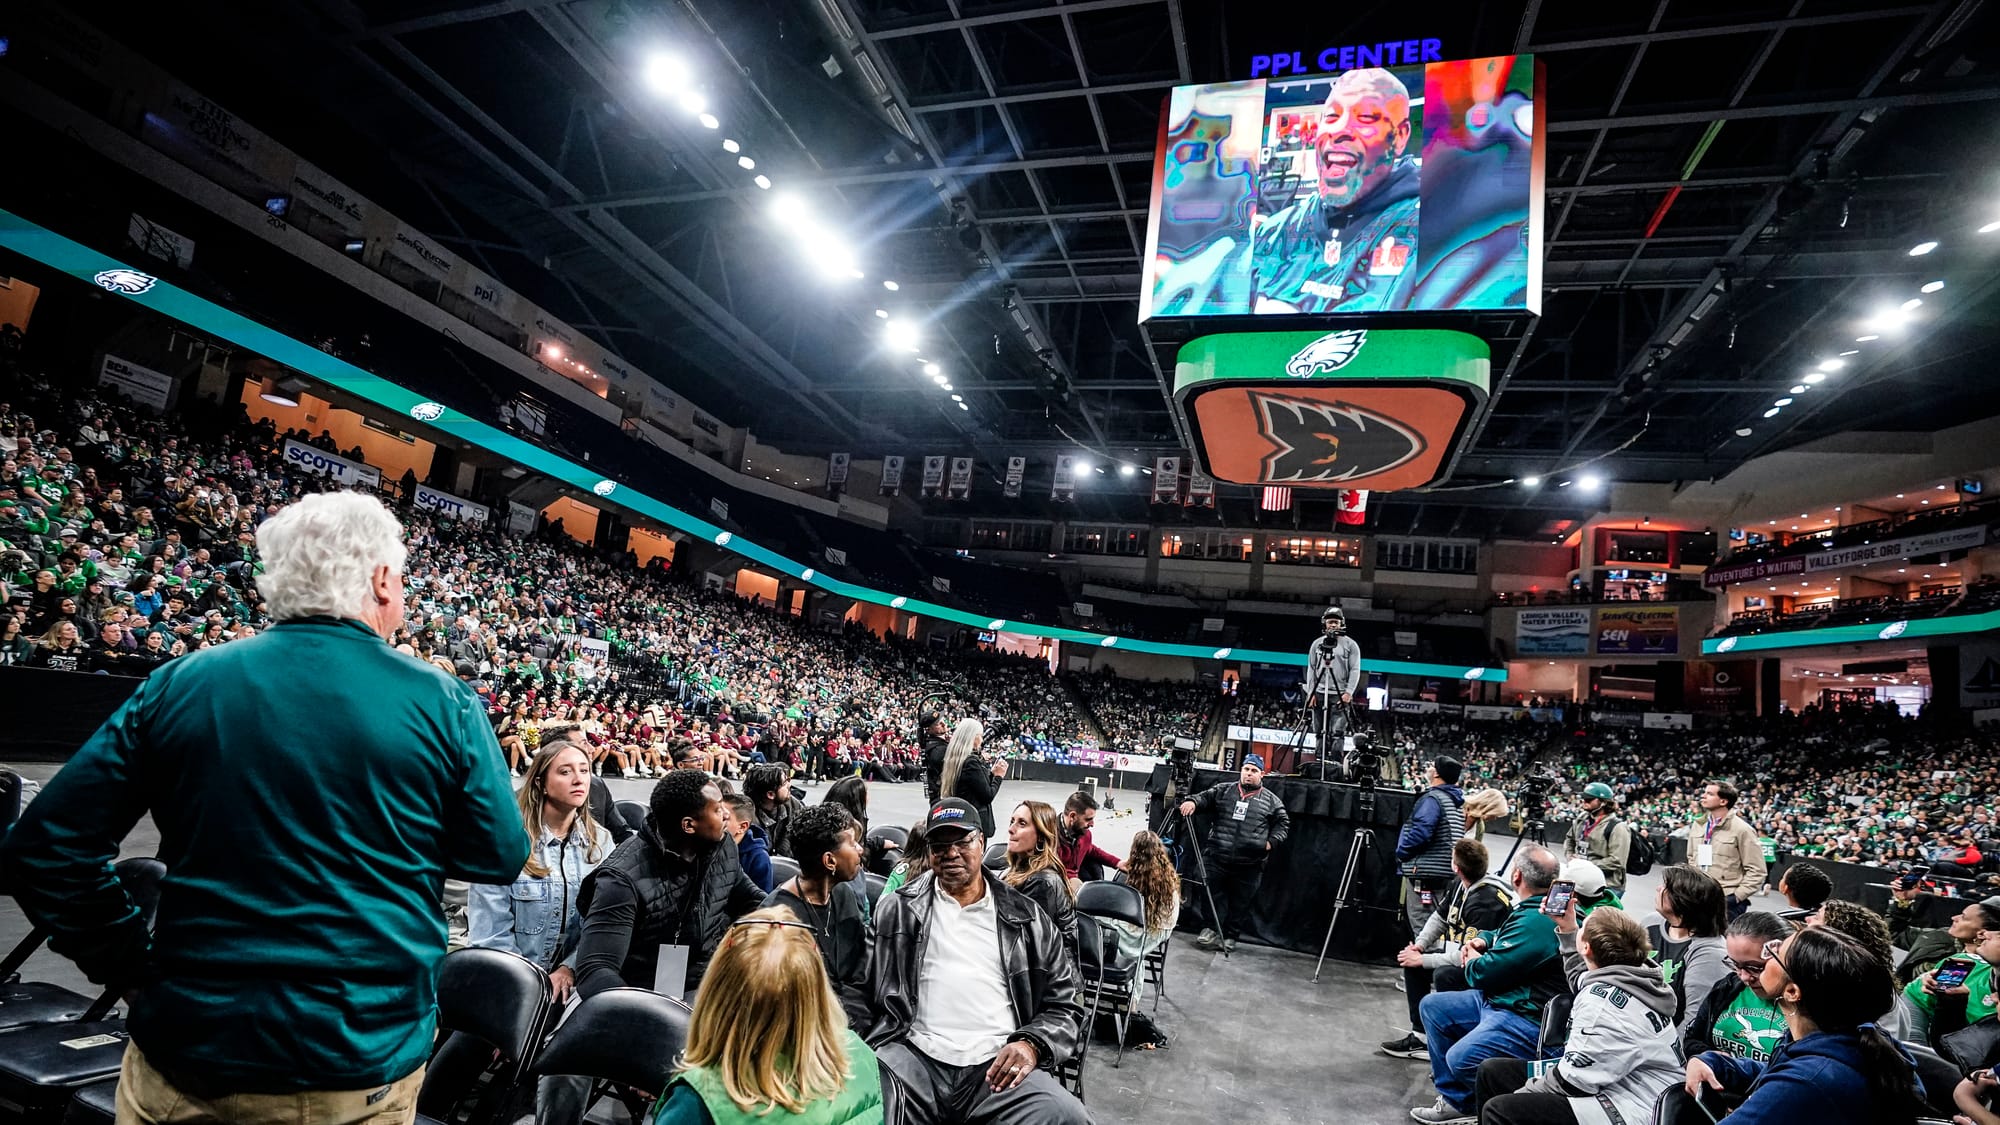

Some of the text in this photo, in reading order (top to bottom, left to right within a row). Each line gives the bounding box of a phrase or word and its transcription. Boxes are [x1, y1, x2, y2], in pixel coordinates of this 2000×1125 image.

[1251, 38, 1442, 78] PPL CENTER
[200, 98, 233, 125] THE
[295, 176, 343, 210] PRODUCTS
[330, 191, 345, 202] AIR
[267, 215, 286, 231] 204
[475, 286, 493, 301] ppl
[288, 447, 347, 476] SCOTT
[418, 491, 463, 514] SCOTT
[1708, 543, 1901, 584] ADVENTURE IS WAITING VALLEYFORGE.ORG
[1600, 629, 1629, 641] SEN
[1393, 702, 1422, 710] SCOTT
[1274, 733, 1311, 745] Subu
[1069, 749, 1083, 758] SEN
[1086, 751, 1100, 760] SEN
[1224, 749, 1235, 771] BS
[1762, 846, 1774, 856] 26
[1589, 982, 1632, 1010] 26
[1713, 1034, 1747, 1058] UPER
